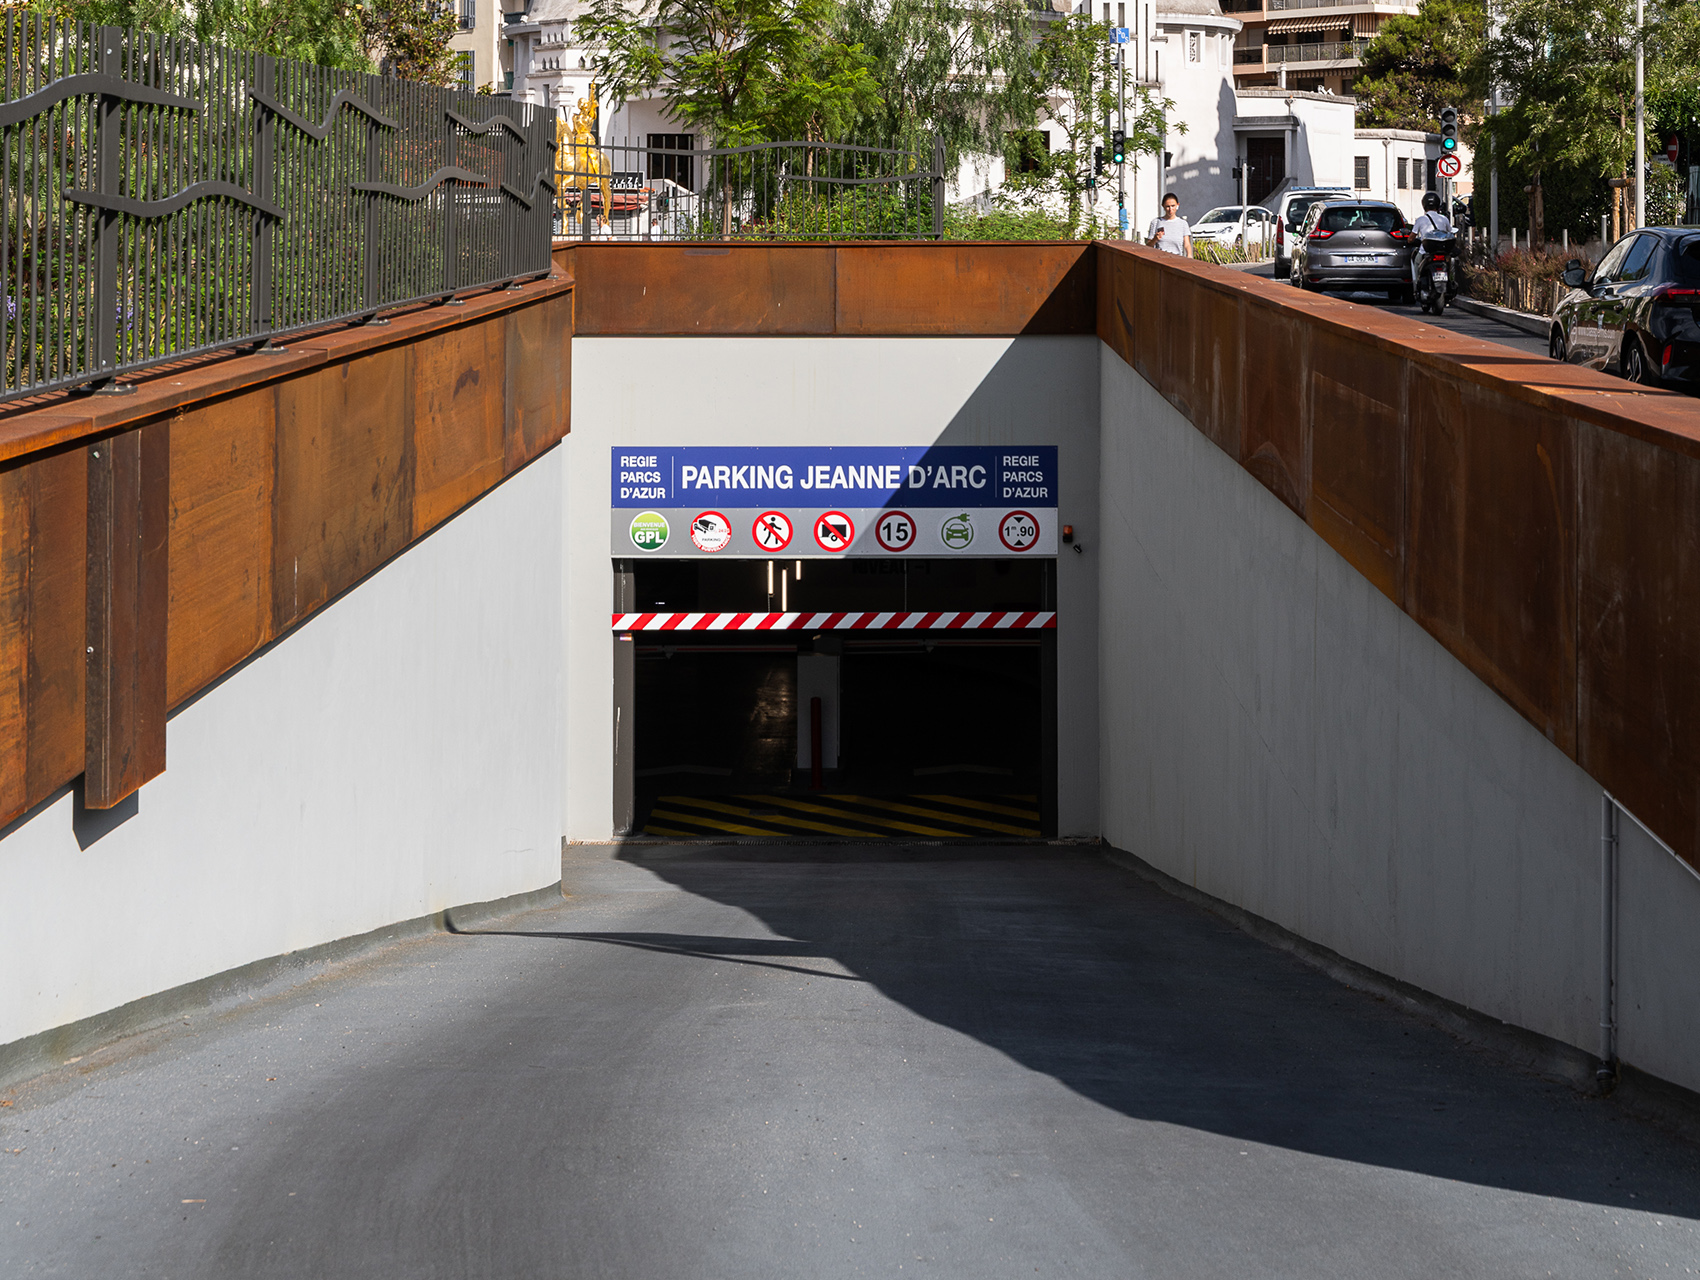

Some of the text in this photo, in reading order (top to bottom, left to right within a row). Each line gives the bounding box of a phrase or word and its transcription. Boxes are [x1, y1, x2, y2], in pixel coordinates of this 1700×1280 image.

[620, 455, 658, 468] REGIE
[1003, 455, 1040, 467] REGIE
[620, 471, 662, 484] PARCS
[681, 464, 988, 490] PARKING JEANNE D'ARC
[1003, 471, 1044, 483] PARCS
[620, 487, 666, 499] D'AZUR
[1003, 487, 1048, 498] D'AZUR
[634, 531, 664, 543] GPL
[883, 522, 909, 542] 15
[852, 559, 909, 575] NIVEAU
